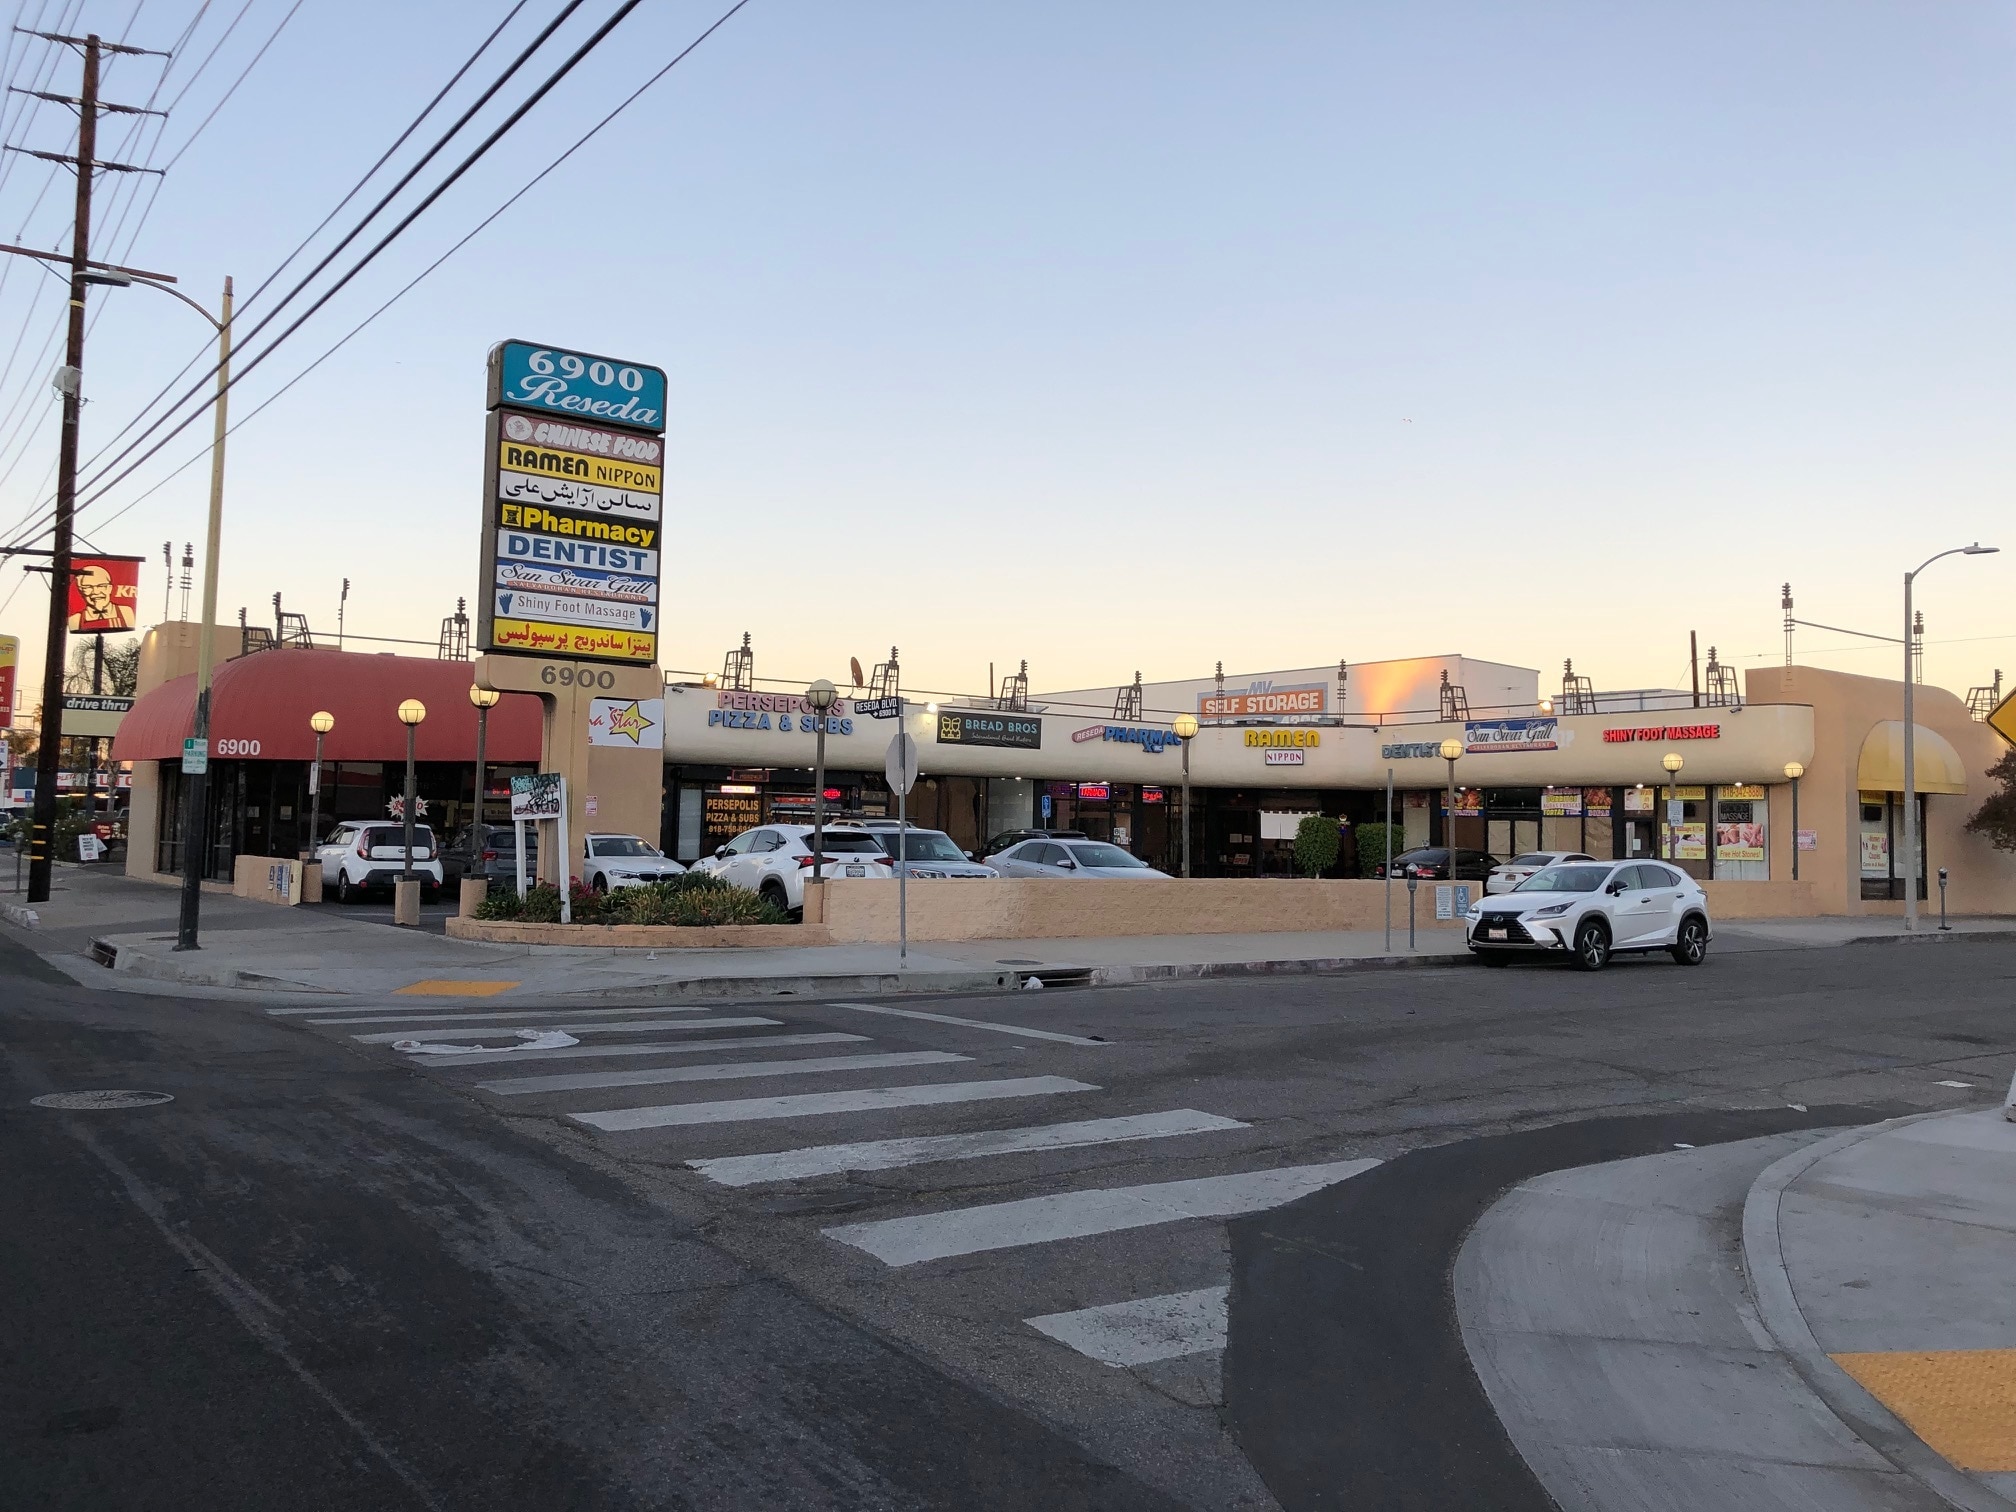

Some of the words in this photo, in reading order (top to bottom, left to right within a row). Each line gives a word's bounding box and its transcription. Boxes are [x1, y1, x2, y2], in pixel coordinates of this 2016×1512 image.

[529, 350, 644, 392] 6900
[506, 374, 658, 424] Reseda
[534, 423, 612, 454] CHINESE
[613, 436, 659, 460] FOOD
[508, 446, 588, 477] RAMEN
[597, 465, 655, 488] NIPPON
[506, 478, 540, 497] علی
[541, 483, 594, 507] آرایش
[597, 493, 651, 512] سالن
[524, 508, 656, 547] Pharmacy
[508, 534, 648, 570] DENTIST
[501, 563, 543, 582] San
[607, 575, 652, 594] Grill
[518, 596, 550, 612] Shiny
[555, 600, 580, 614] Foot
[585, 603, 636, 620] Massage
[541, 666, 615, 690] 6900
[1246, 680, 1273, 695] MV
[66, 698, 100, 710] drive
[102, 700, 128, 711] thru
[718, 691, 844, 716] PERSEPOS
[856, 700, 880, 712] RESEDA
[1247, 692, 1319, 713] STORAGE
[608, 709, 642, 730] Star
[709, 710, 772, 730] PIZZA
[780, 714, 793, 731] &
[965, 719, 1004, 732] BREAD
[1008, 722, 1038, 734] BROS
[1076, 726, 1104, 740] RESEDA
[1244, 730, 1320, 748] RAMEN
[1467, 724, 1490, 743] San
[1603, 729, 1636, 742] SHINY
[1637, 727, 1667, 741] FOOT
[1666, 724, 1720, 740] MASSAGE
[218, 738, 260, 756] 6900
[1382, 742, 1442, 759] DENTIST
[1267, 752, 1301, 762] NIPPON
[706, 798, 759, 811] PERSEPOLIS
[706, 813, 729, 822] PIZZA
[730, 814, 737, 822] &
[738, 814, 760, 823] SUBS
[1720, 850, 1731, 858] Free
[1732, 850, 1740, 858] Hot
